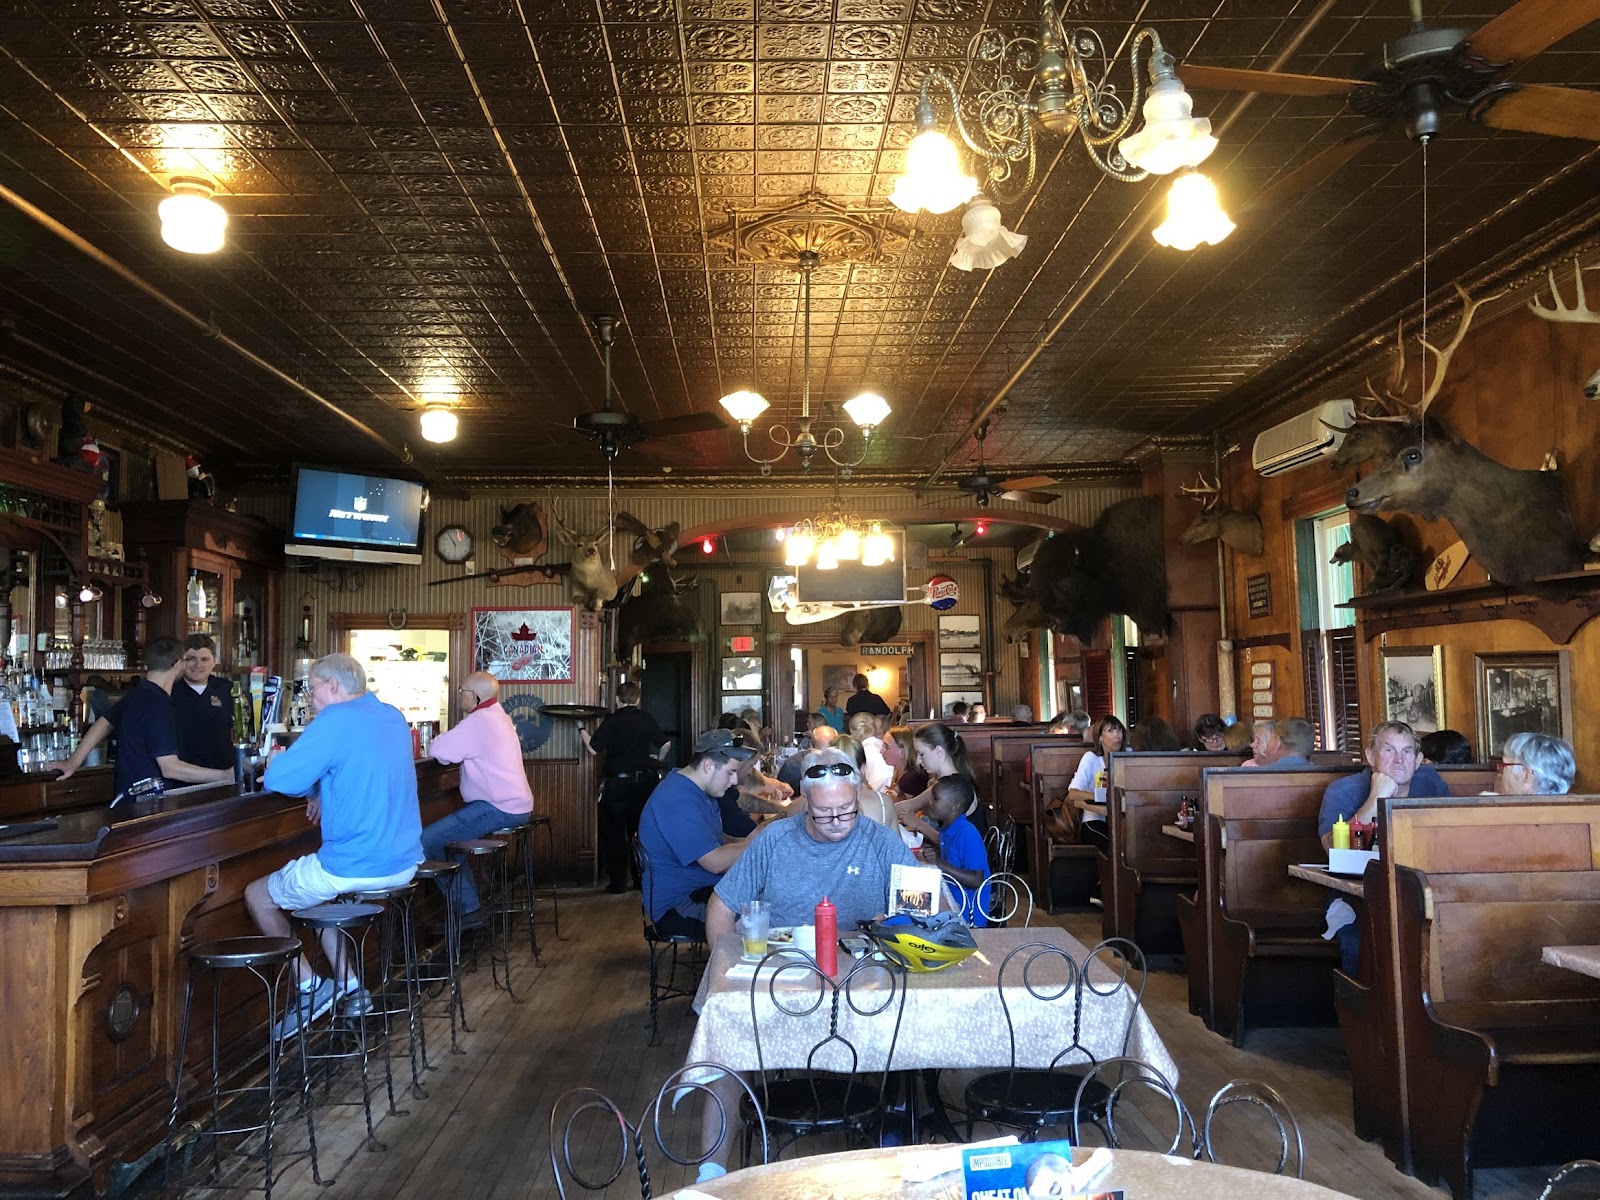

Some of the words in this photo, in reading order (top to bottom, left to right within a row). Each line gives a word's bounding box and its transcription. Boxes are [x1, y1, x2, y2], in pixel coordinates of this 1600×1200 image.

[503, 644, 545, 655] CANADIAN
[862, 646, 915, 655] RANDOLPH
[908, 942, 936, 954] Giro
[972, 1155, 1008, 1168] IMPOSSIBLE
